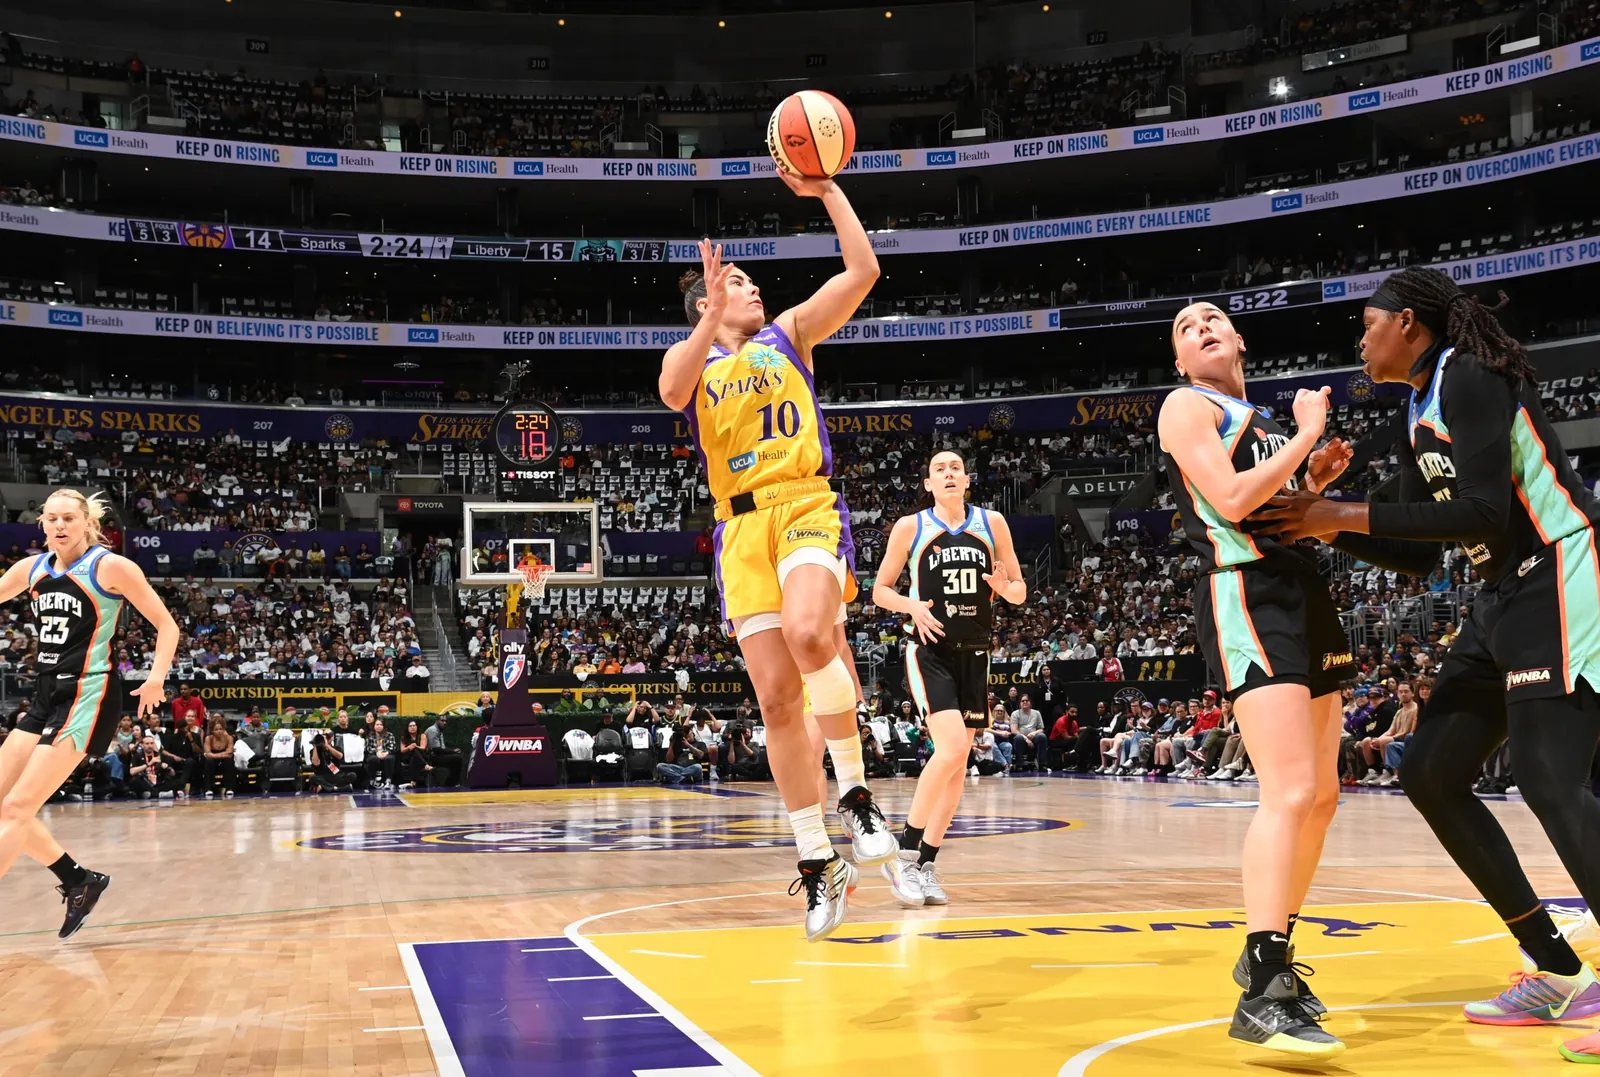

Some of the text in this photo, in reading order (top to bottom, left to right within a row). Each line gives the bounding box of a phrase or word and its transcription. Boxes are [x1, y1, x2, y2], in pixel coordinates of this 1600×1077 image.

[250, 42, 266, 51] 309
[532, 60, 546, 68] 310
[1446, 55, 1552, 92] KEEP ON RISING
[1352, 88, 1418, 107] UCLA Health
[1226, 103, 1322, 133] KEEP ON RISING
[0, 119, 46, 140] RISING
[1138, 126, 1200, 141] UCLA Health
[79, 133, 148, 150] UCLA Health
[1014, 134, 1108, 158] KEEP ON RISING
[176, 140, 280, 163] KEEP ON RISING
[930, 150, 990, 163] UCLA Health
[310, 154, 374, 167] UCLA Health
[400, 156, 497, 174] KEEP ON RISING
[862, 154, 902, 168] RISING
[518, 164, 578, 174] UCLA Health
[603, 162, 697, 176] KEEP ON RISING
[726, 164, 747, 173] UCLA
[1404, 172, 1438, 190] KEEP
[1443, 168, 1462, 184] ON
[1466, 149, 1555, 181] OVERCOMING
[1276, 190, 1339, 208] UCLA Health
[0, 211, 38, 226] Health
[960, 208, 1211, 246] KEEP ON OVERCOMING EVERY CHALLENGE
[140, 229, 170, 242] 5 3
[246, 231, 271, 249] 14
[301, 238, 346, 250] Sparks
[370, 236, 423, 258] 2:24
[439, 245, 446, 258] 1
[467, 244, 511, 258] Liberty
[711, 242, 776, 257] CALLENGE
[539, 244, 564, 260] 15
[630, 250, 659, 260] 3 5
[1453, 264, 1472, 281] ON
[1476, 252, 1545, 278] BELIEVING
[1550, 246, 1574, 265] IT'S
[1228, 289, 1288, 312] 5:22
[53, 312, 124, 328] UCLA Health
[863, 324, 879, 338] ON
[884, 322, 946, 338] BELIEVING
[950, 320, 971, 334] IT'S
[976, 315, 1032, 333] POSSIBLE
[156, 316, 378, 342] KEEP ON BELIEVING IT'S POSSIBLE
[412, 332, 475, 342] UCLA Health
[504, 331, 534, 345] KEEP
[538, 331, 555, 345] ON
[559, 331, 622, 345] BELIEVING
[626, 331, 648, 345] IT'S
[1276, 390, 1294, 400] 210
[100, 410, 200, 433] SPARKS
[253, 420, 273, 430] 207
[516, 414, 548, 430] 2:24
[756, 400, 800, 442] 10
[826, 413, 913, 434] SPARKS
[935, 416, 955, 425] 209
[631, 424, 651, 434] 208
[522, 430, 546, 458] 18
[731, 449, 789, 470] UCLA Health
[516, 471, 556, 479] TISSOT
[1085, 480, 1136, 493] DELTA
[132, 536, 160, 548] 106
[942, 568, 978, 594] 30
[40, 616, 70, 644] 23
[504, 642, 524, 654] ally
[1512, 671, 1550, 684] WNBA
[700, 682, 742, 694] CLUB
[498, 739, 542, 751] WNBA
